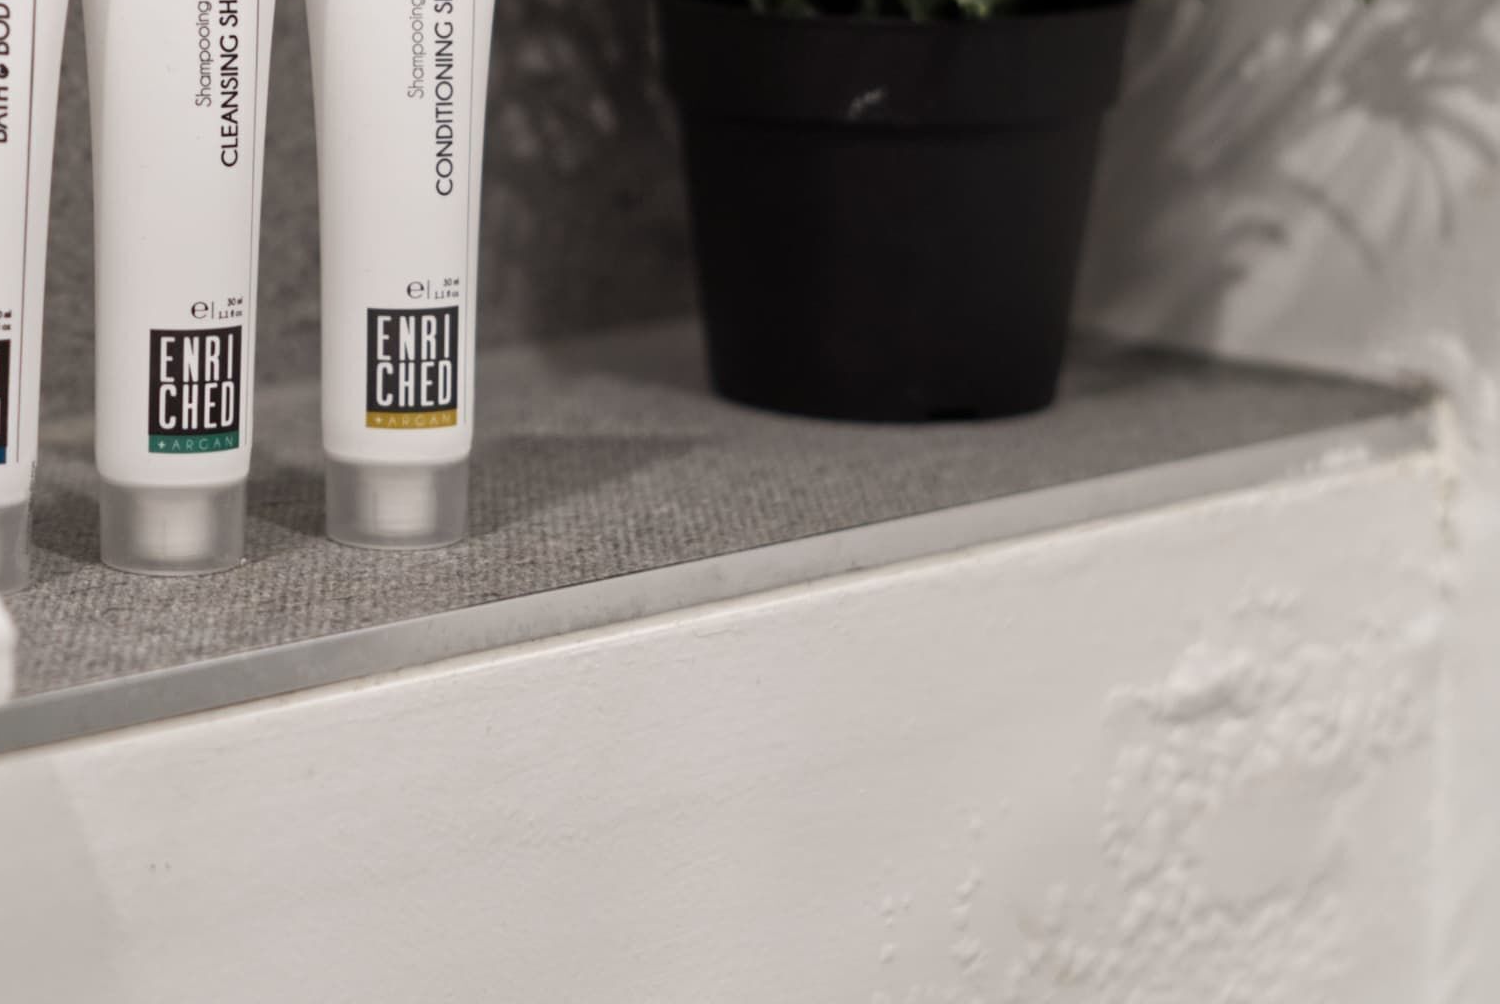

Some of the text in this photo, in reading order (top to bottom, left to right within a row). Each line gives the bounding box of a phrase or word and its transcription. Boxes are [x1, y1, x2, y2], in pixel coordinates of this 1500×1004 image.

[195, 0, 212, 107] Shampooing
[219, 36, 239, 167] CLEANSING
[435, 22, 454, 196] CONDITIONING
[160, 333, 234, 383] ENRI
[376, 313, 451, 361] ENRI
[159, 381, 235, 429] CHED
[375, 359, 452, 407] CHED
[171, 436, 234, 451] ARGAN
